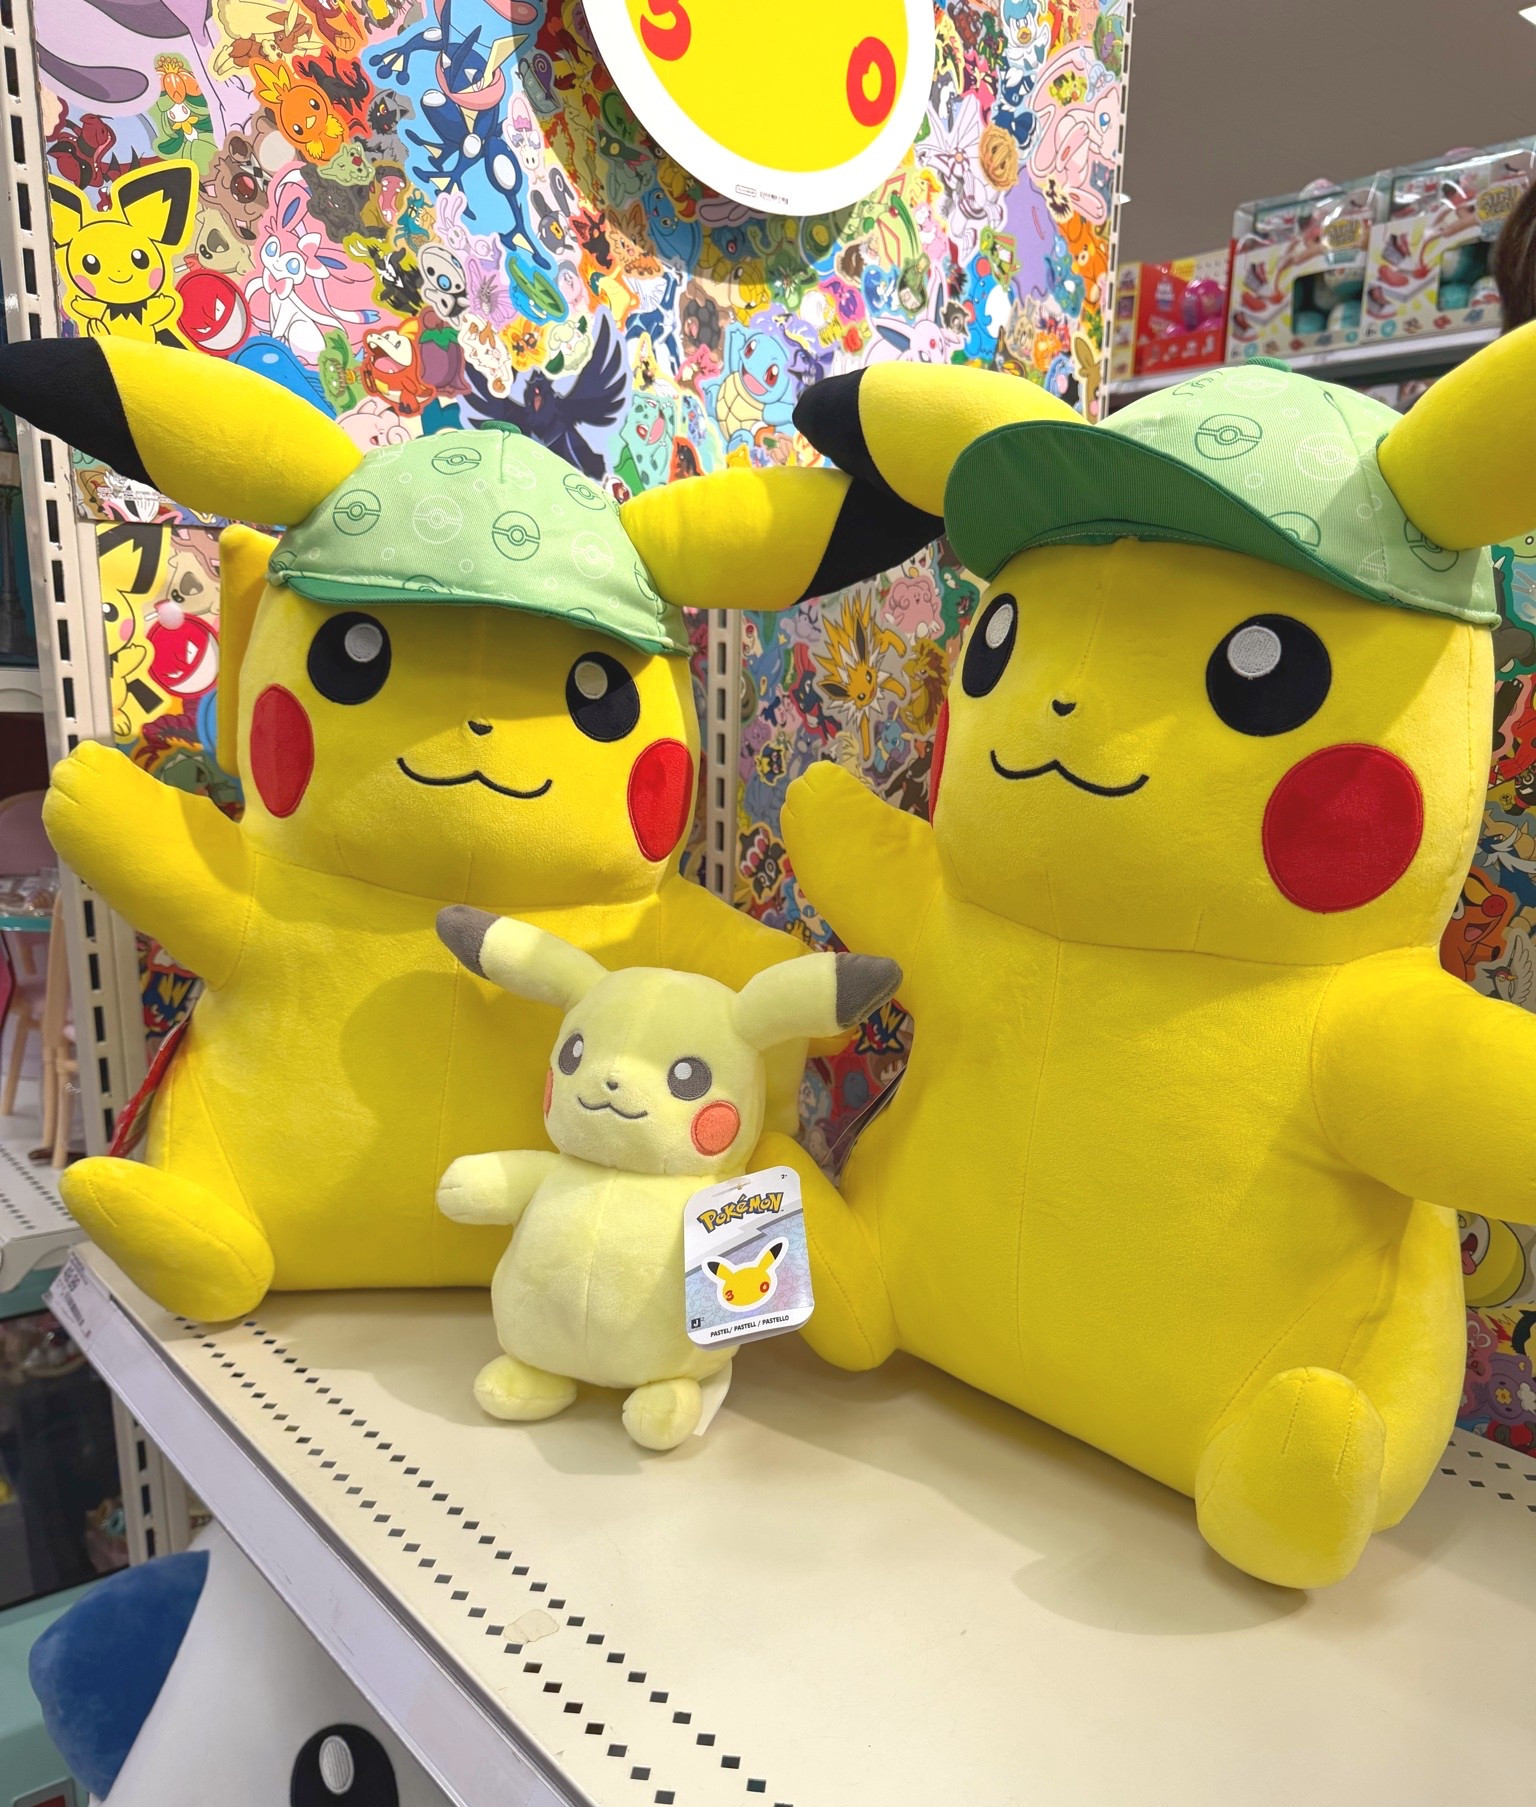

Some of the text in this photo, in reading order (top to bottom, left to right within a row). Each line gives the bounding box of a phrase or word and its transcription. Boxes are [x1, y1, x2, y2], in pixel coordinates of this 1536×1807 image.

[846, 36, 897, 127] 0
[725, 1281, 770, 1301] 3 0
[734, 1322, 756, 1331] PASTELL
[762, 1315, 789, 1326] PASTELLO
